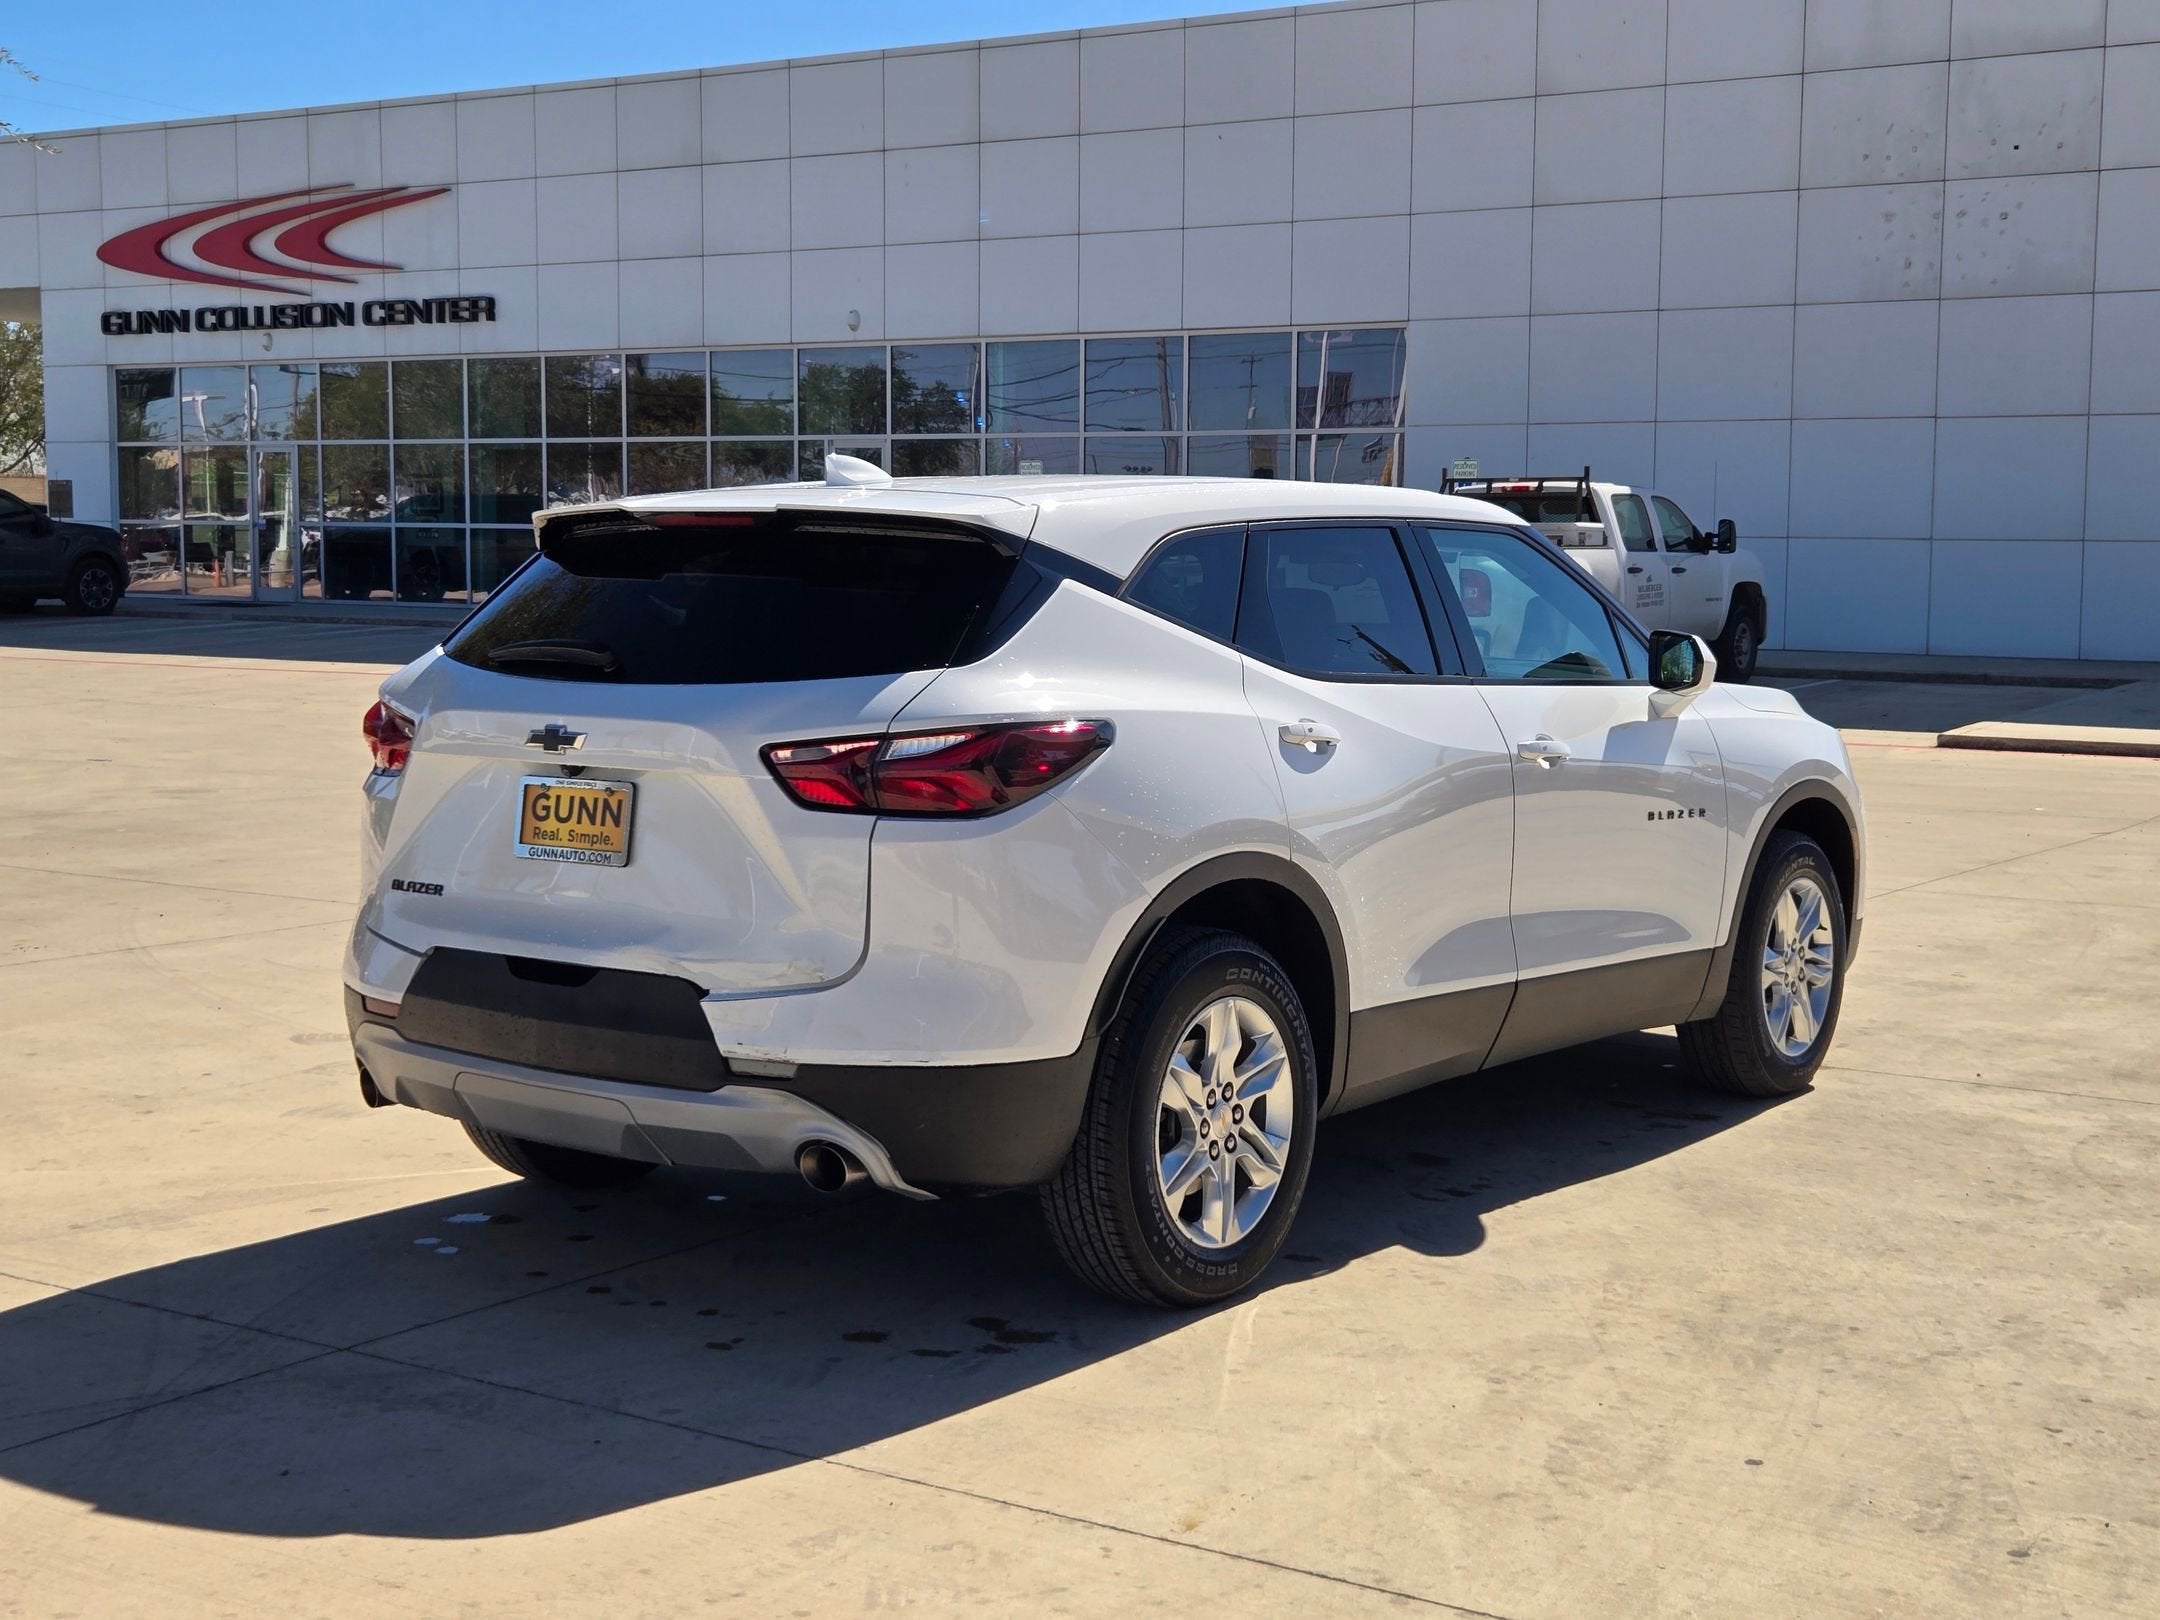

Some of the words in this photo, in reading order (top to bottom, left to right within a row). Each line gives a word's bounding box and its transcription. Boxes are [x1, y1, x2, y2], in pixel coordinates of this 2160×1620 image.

[100, 310, 190, 335] GUNN
[195, 301, 355, 332] COLLISION
[361, 296, 497, 326] CENTER
[531, 792, 623, 828] GUNN
[1647, 807, 1707, 821] BLAZER
[533, 827, 562, 841] Real.
[528, 846, 612, 864] GUNNAUTO.COM
[391, 878, 445, 897] BLAZER
